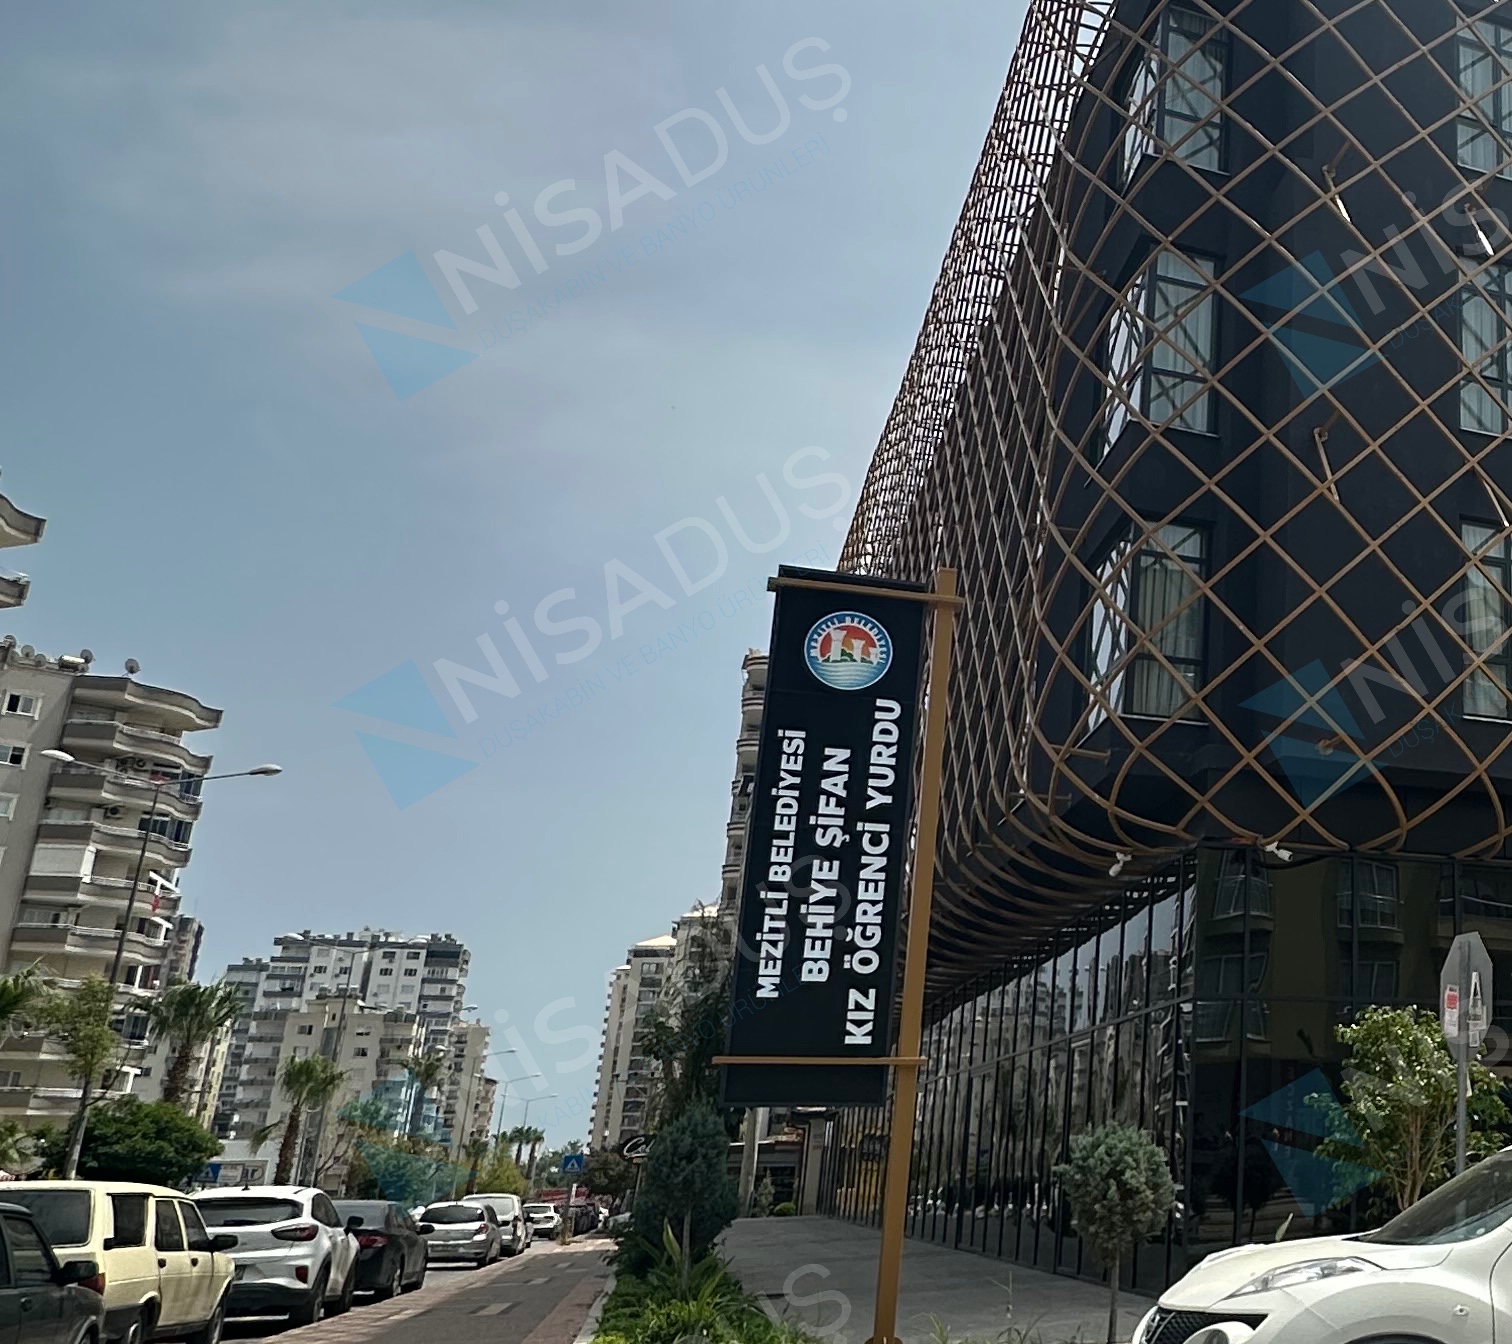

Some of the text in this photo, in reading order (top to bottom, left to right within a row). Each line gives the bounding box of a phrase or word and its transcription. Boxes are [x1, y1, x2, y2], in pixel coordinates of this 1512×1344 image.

[755, 729, 806, 999] MEZİTLİ BELEDİYESİ
[801, 747, 852, 983] BEHİYE ŞİFAN
[844, 698, 902, 1046] KIZ ÖĞRENCİ YURDU
